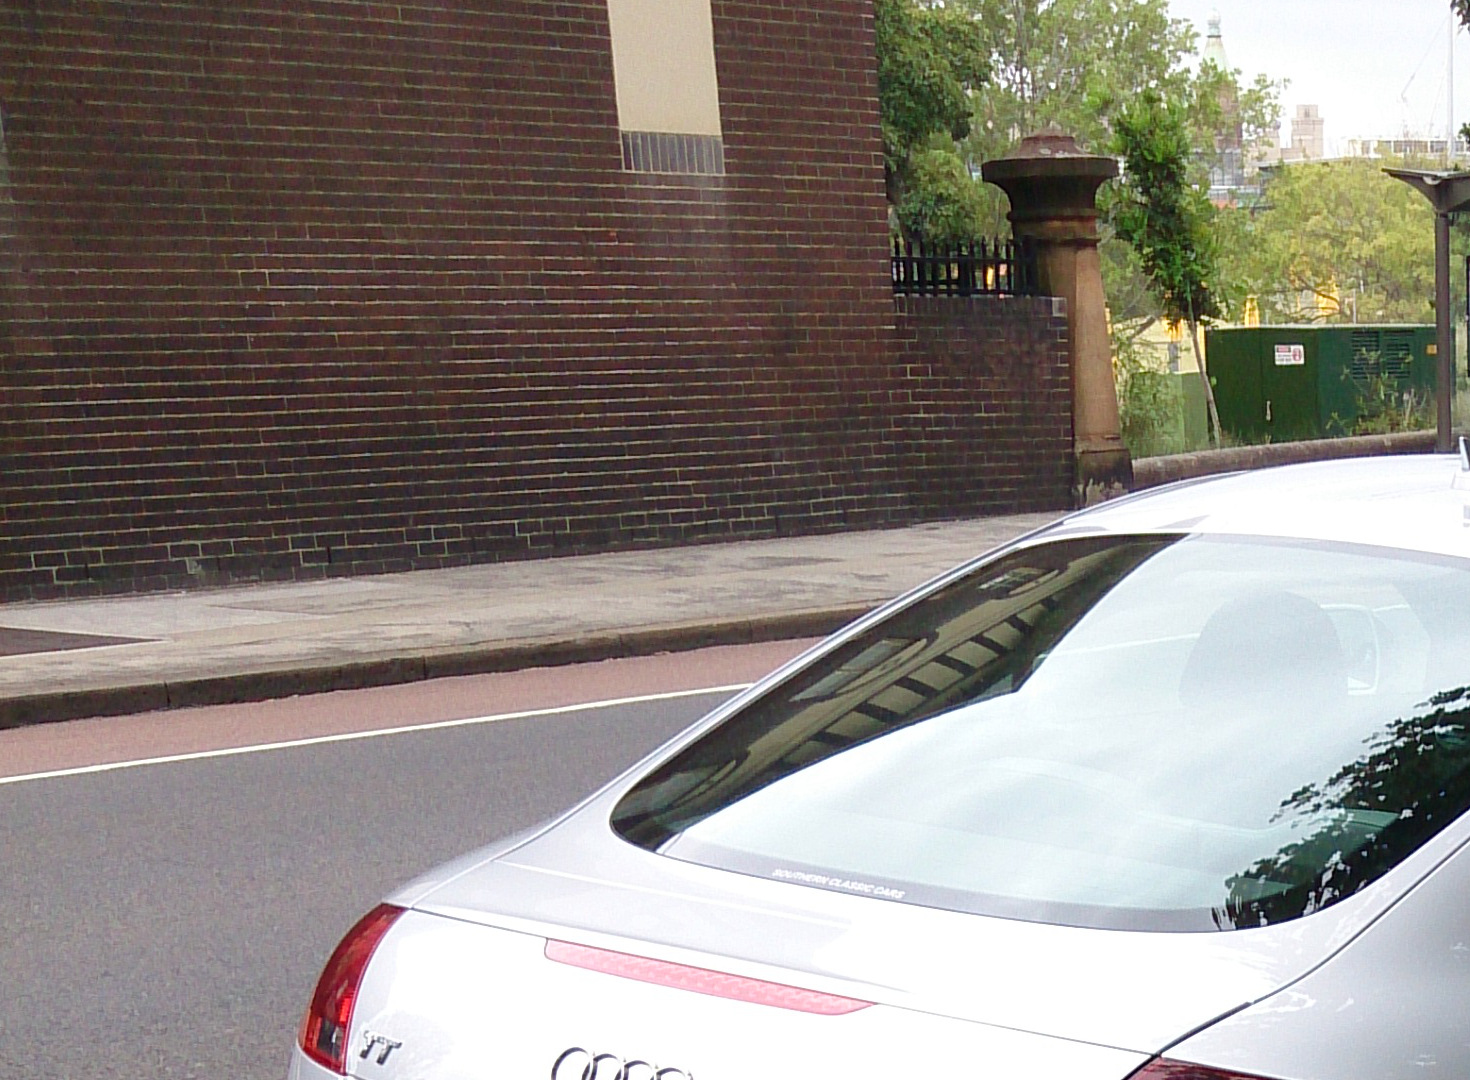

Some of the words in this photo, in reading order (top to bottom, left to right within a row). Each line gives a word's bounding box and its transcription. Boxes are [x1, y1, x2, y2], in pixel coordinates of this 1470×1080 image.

[772, 868, 829, 886] SOUTHERN
[829, 877, 875, 893] CLASSIC
[873, 886, 906, 899] CARS
